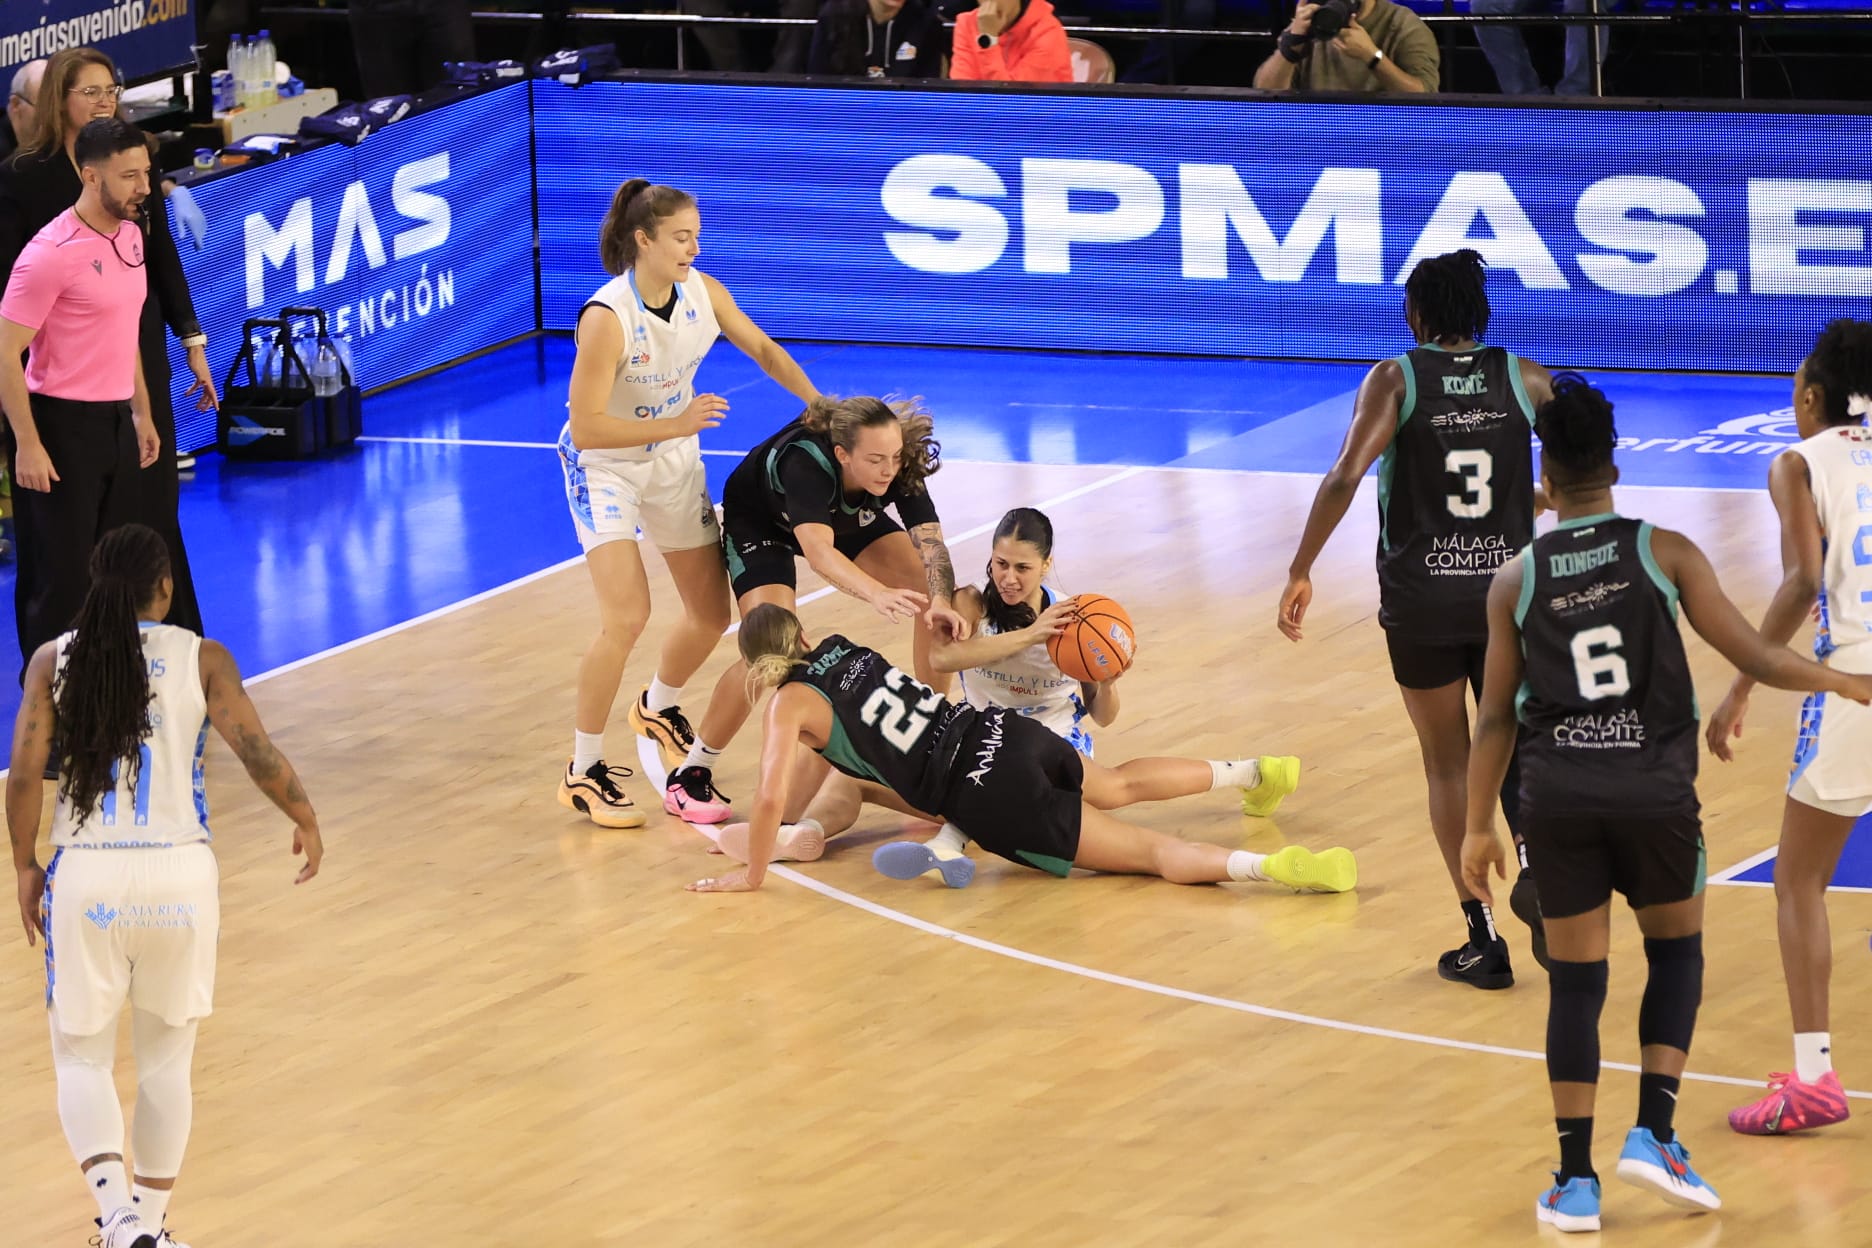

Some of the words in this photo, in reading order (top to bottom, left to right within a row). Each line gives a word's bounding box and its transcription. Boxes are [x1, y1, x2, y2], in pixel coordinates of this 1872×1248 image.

[244, 151, 452, 310] MAS
[880, 153, 1872, 298] SPMAS.E
[1442, 369, 1488, 395] KONÉ
[1445, 449, 1493, 519] 3
[1433, 533, 1506, 551] MÁLAGA
[1549, 541, 1620, 578] DONGUE
[1570, 625, 1631, 700] 6
[861, 667, 946, 756] 23
